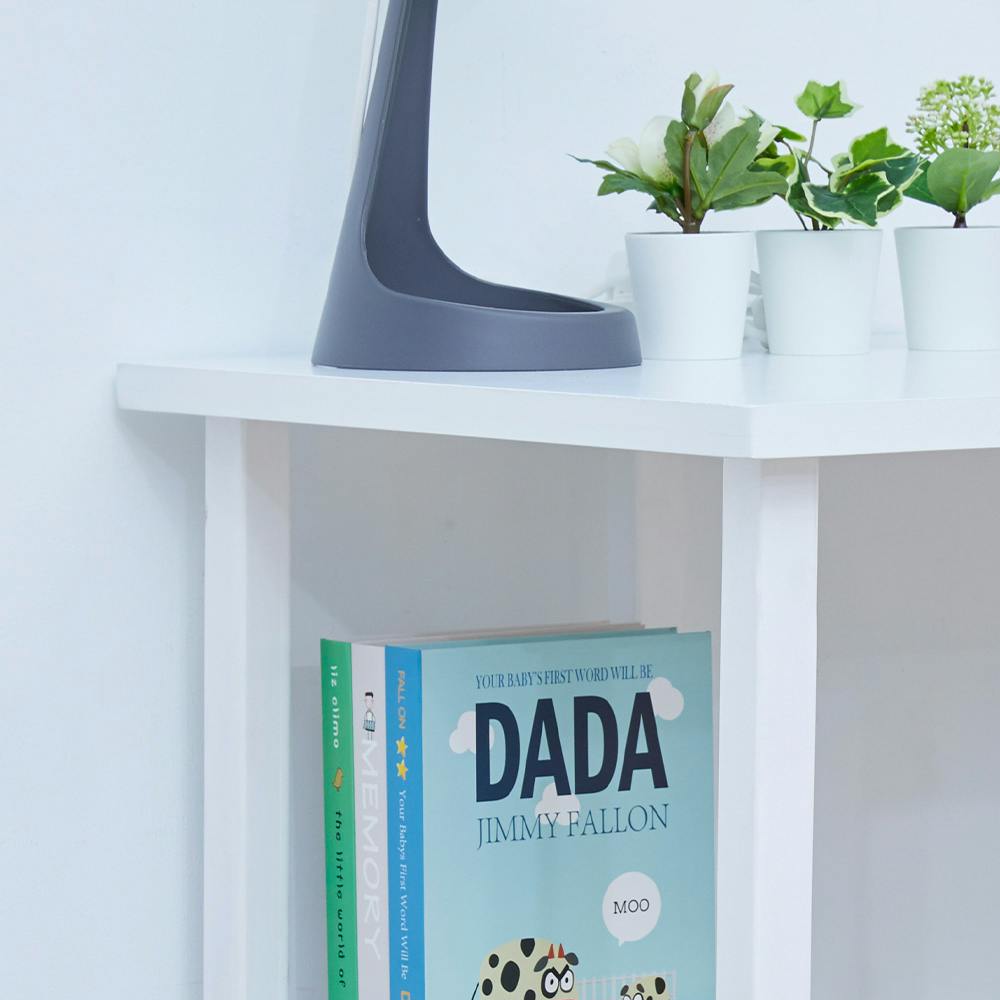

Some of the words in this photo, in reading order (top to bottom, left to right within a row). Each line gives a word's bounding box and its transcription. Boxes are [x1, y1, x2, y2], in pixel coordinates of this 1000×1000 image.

[330, 665, 339, 687] liz
[475, 674, 505, 689] YOUR
[544, 669, 574, 685] FIRST
[574, 668, 609, 684] WORD
[610, 665, 638, 681] WILL
[639, 664, 654, 679] BE
[475, 691, 669, 803] DADA
[399, 790, 407, 821] Your
[476, 812, 561, 850] JIMMY
[567, 803, 670, 837] FALLON
[361, 737, 381, 960] MEMORY
[400, 864, 408, 891] First
[400, 895, 409, 931] Word
[613, 898, 650, 915] MOO
[337, 909, 345, 959] world
[401, 935, 409, 961] Will
[338, 968, 346, 988] of
[401, 965, 409, 980] Be
